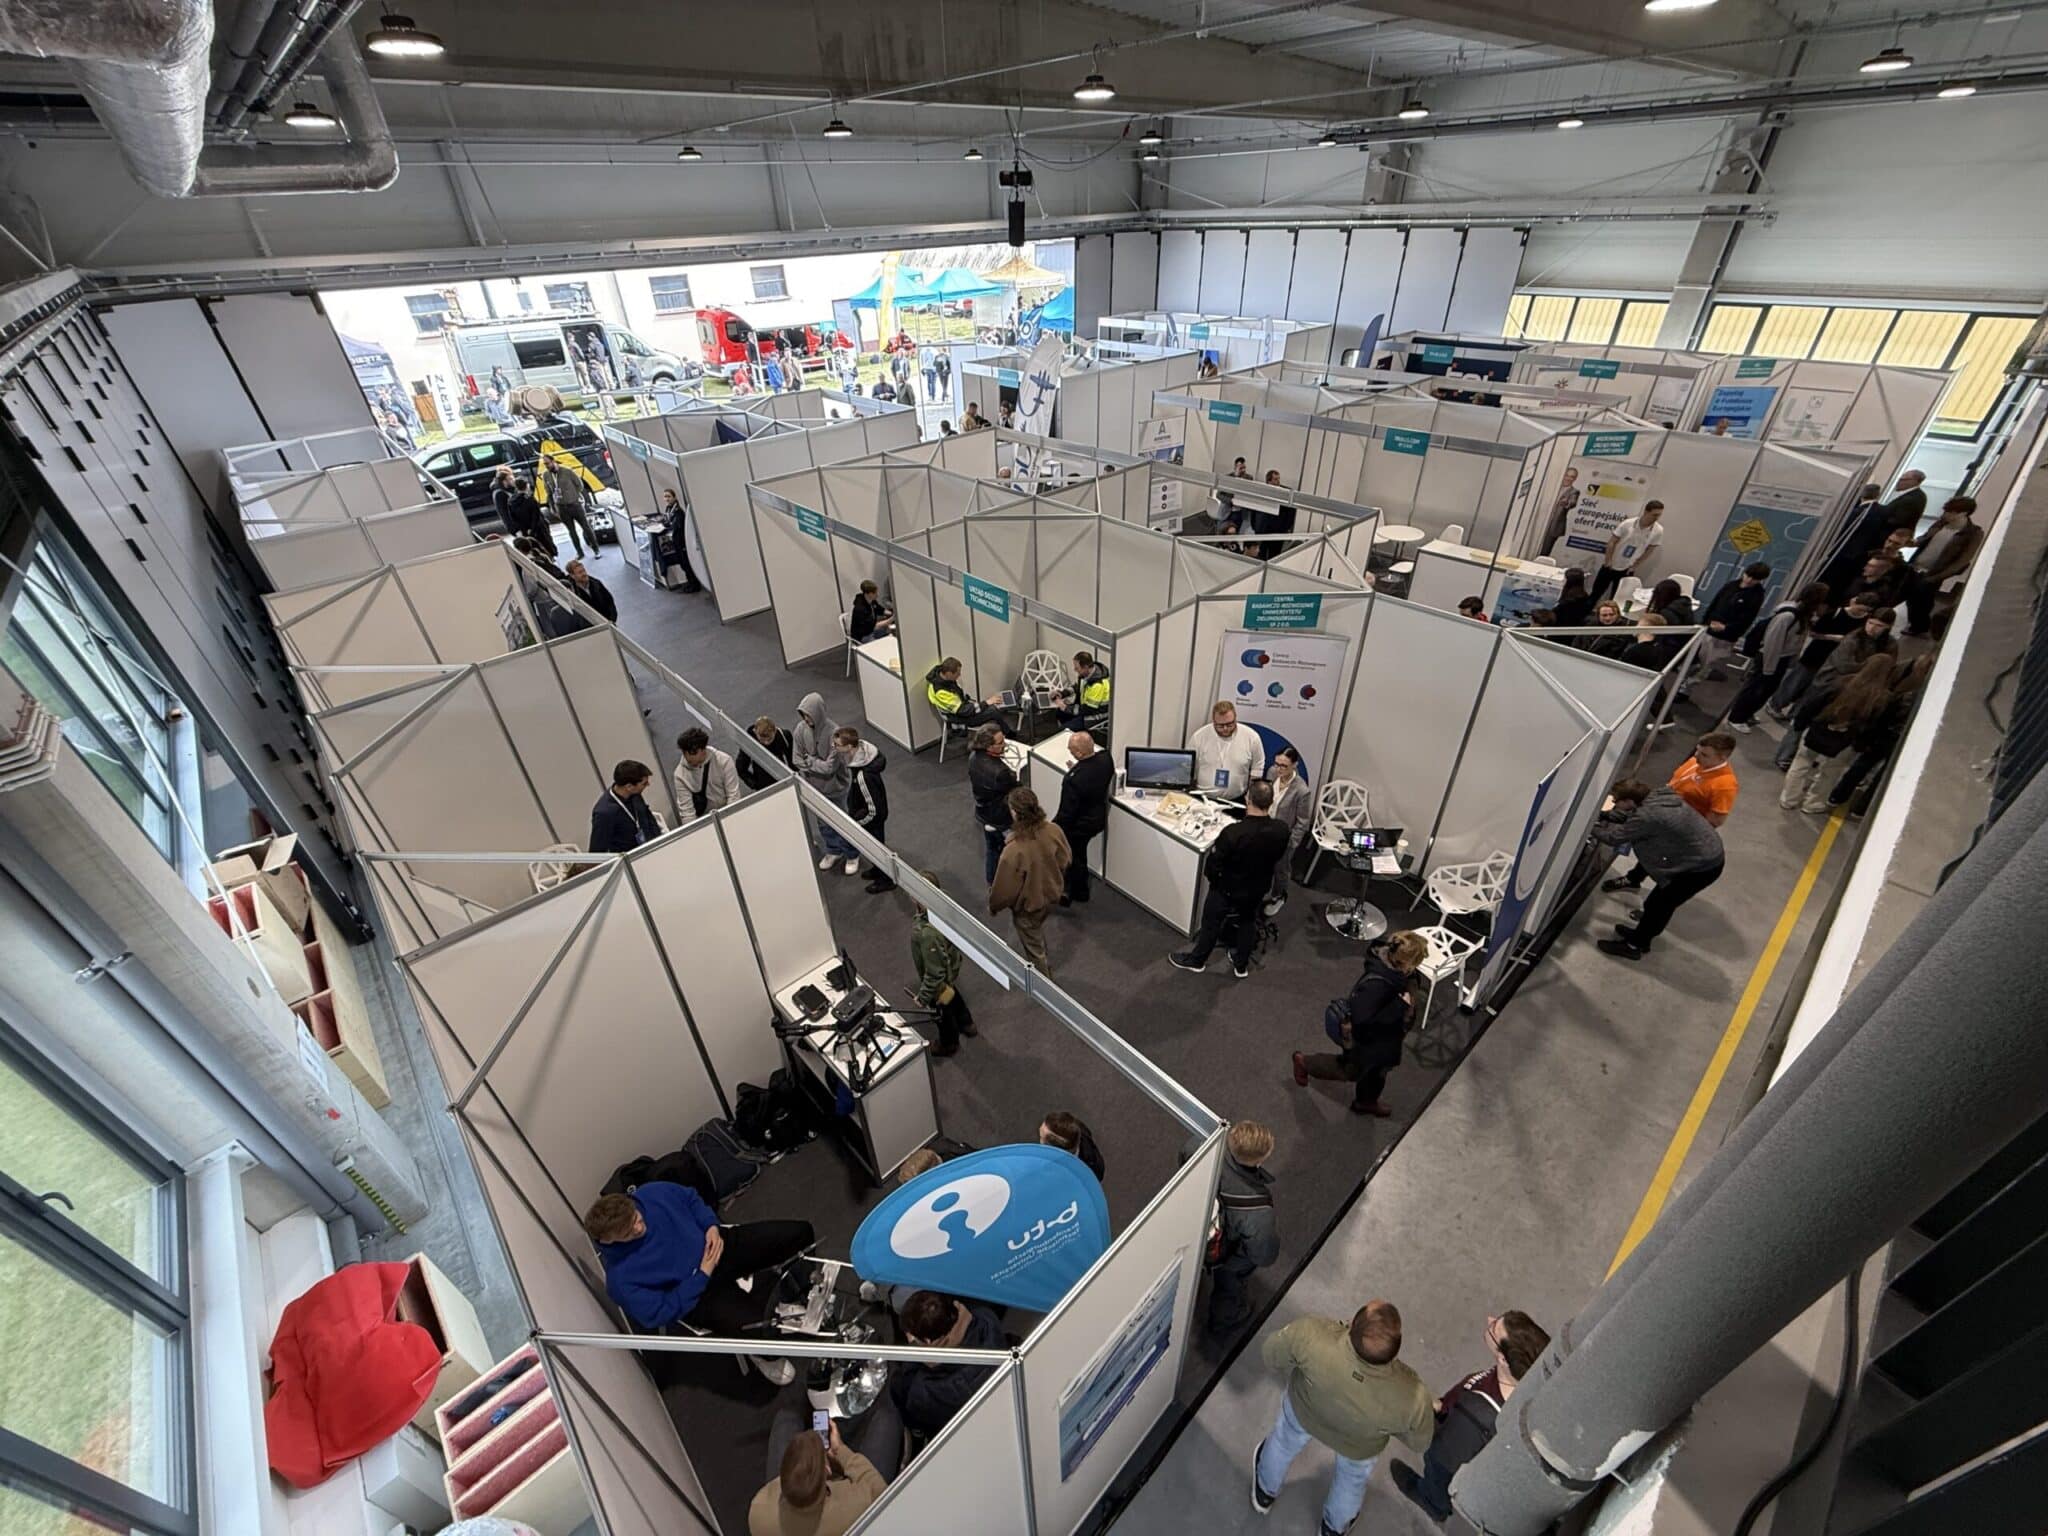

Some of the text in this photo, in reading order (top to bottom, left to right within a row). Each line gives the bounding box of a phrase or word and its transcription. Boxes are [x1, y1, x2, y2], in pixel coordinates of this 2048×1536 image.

[434, 374, 456, 422] HERTZ
[1580, 498, 1598, 507] Sieć
[1574, 515, 1595, 526] ofert
